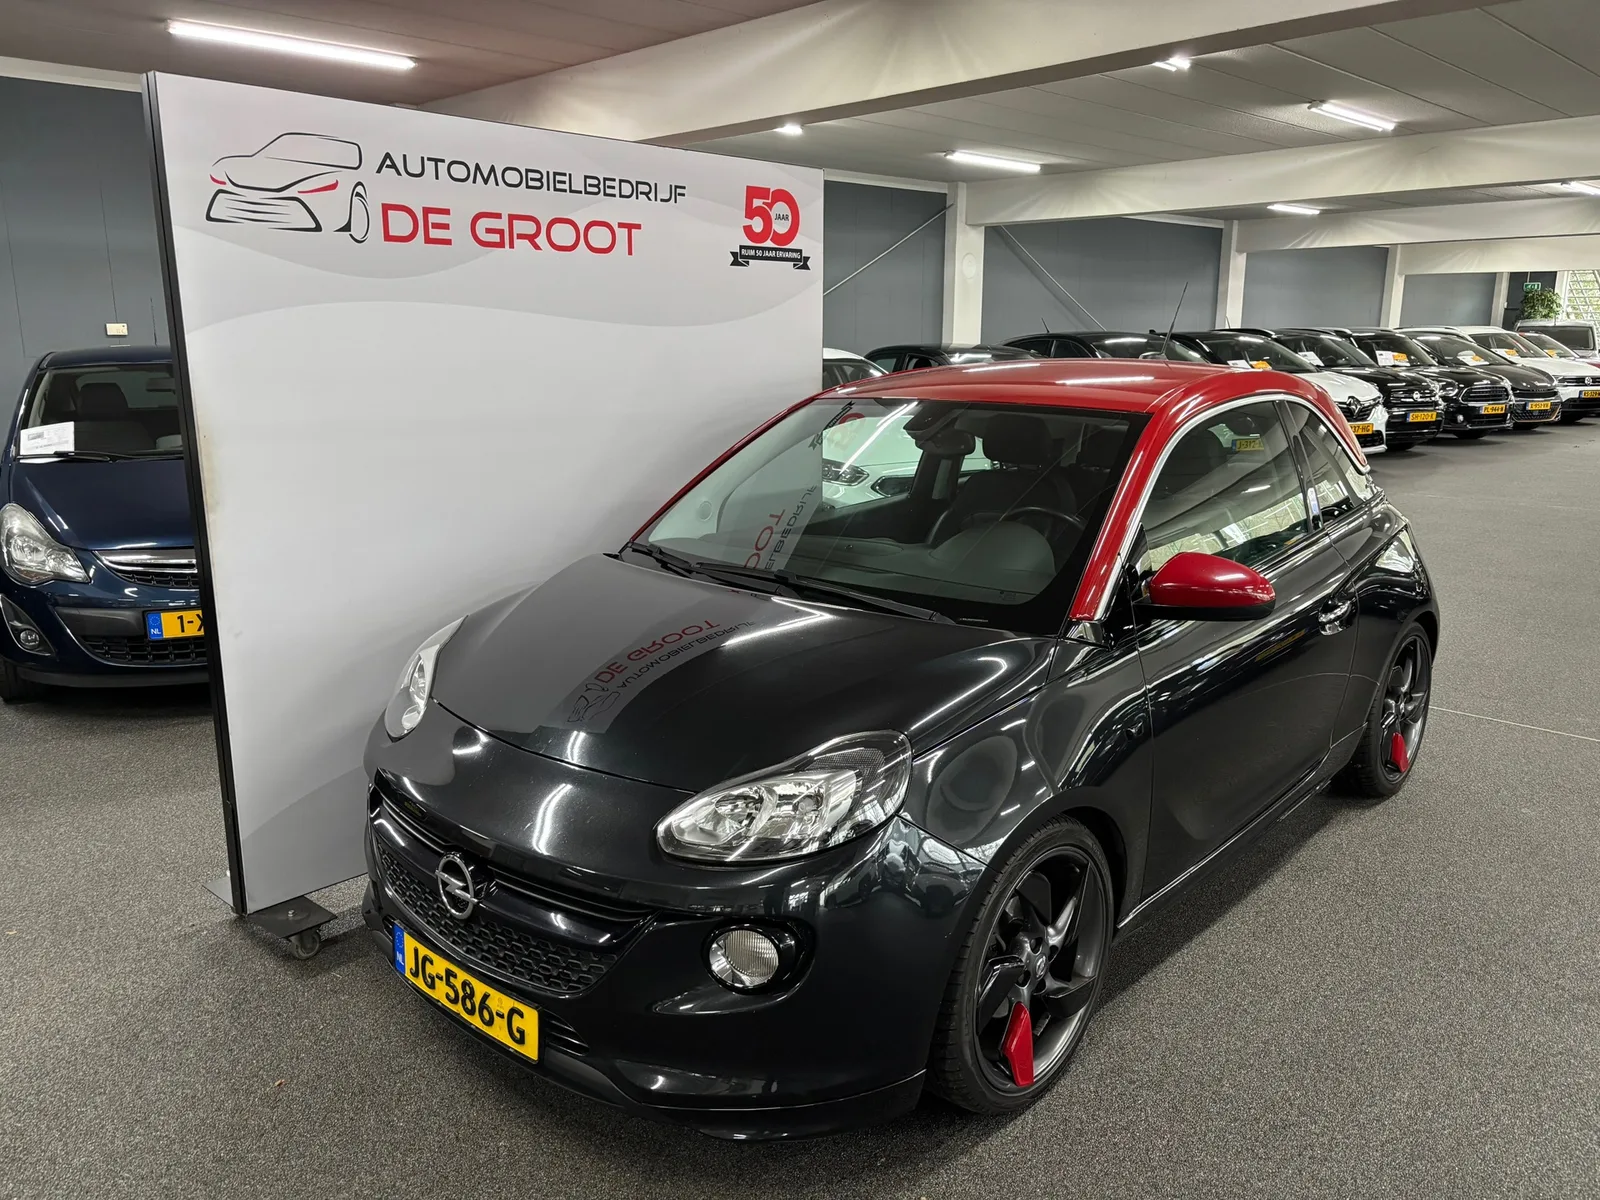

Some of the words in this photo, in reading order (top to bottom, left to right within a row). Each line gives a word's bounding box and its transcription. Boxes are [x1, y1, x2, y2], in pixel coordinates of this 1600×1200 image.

[376, 152, 686, 204] AUTOMOBIELBEDRIJF
[381, 203, 452, 246] DE
[470, 211, 641, 256] GROOT
[743, 185, 800, 247] 50
[774, 213, 789, 221] JAAR
[741, 248, 756, 256] RUIM
[756, 249, 762, 257] 50
[763, 250, 776, 258] JAAR
[776, 251, 801, 259] ERVARING
[409, 946, 526, 1046] JG-586-G
